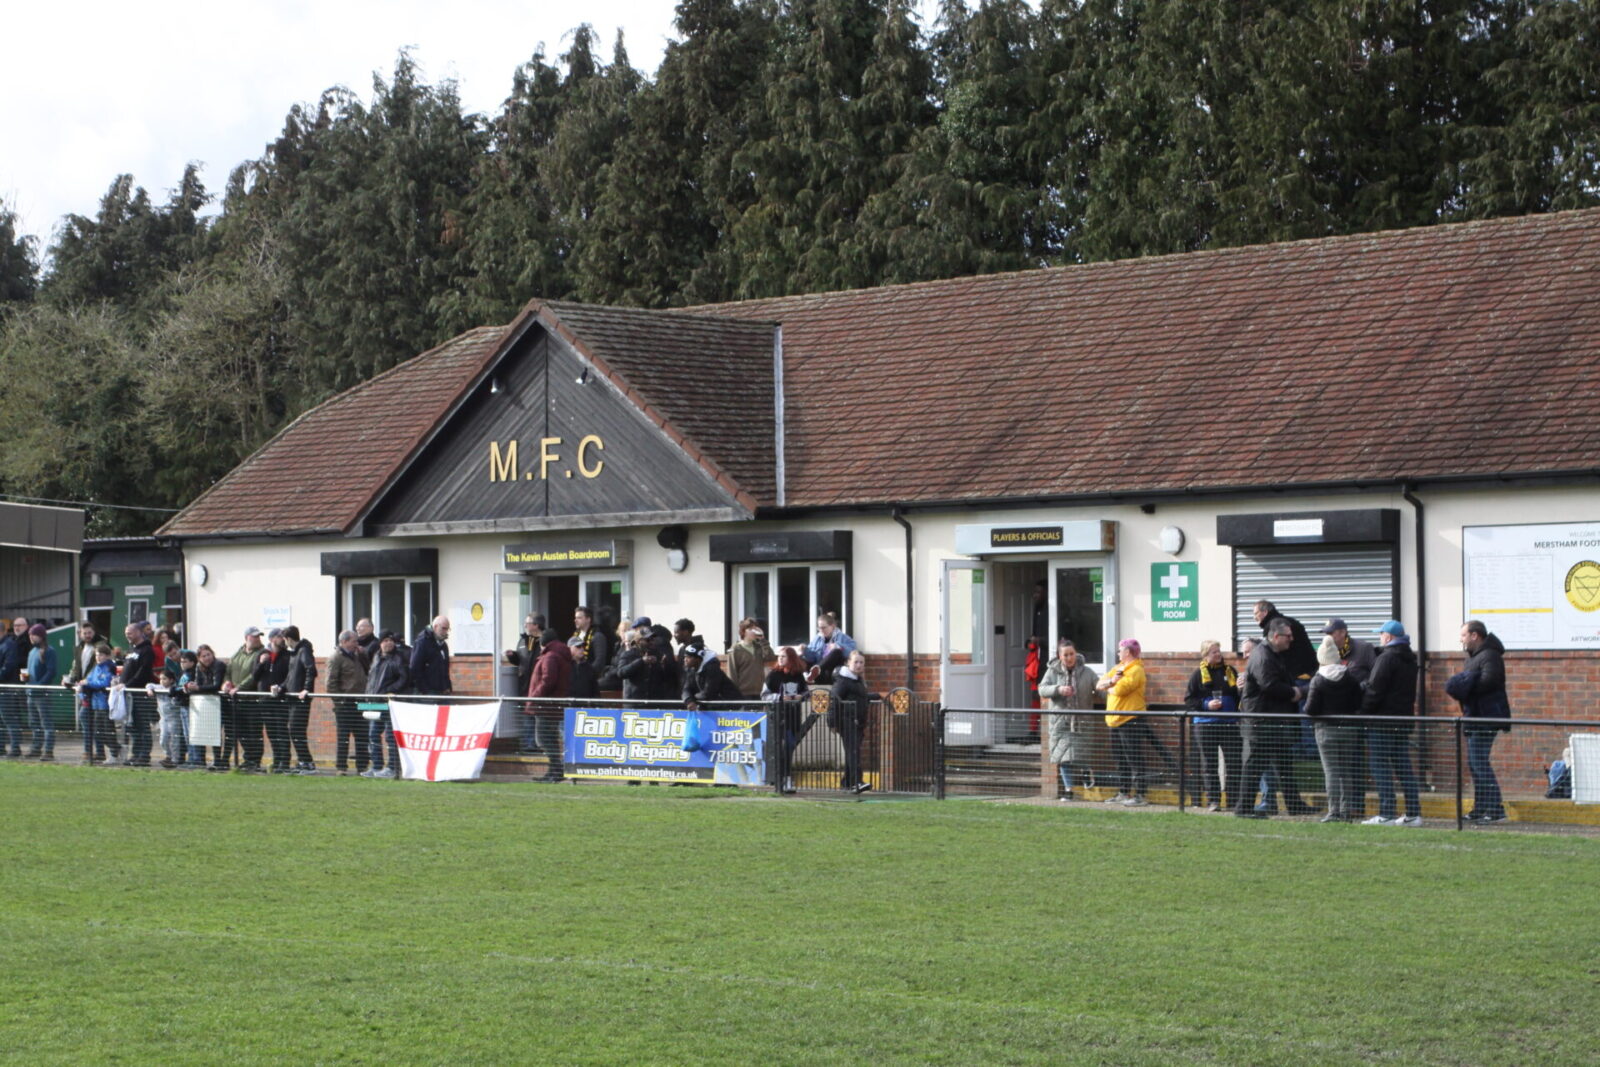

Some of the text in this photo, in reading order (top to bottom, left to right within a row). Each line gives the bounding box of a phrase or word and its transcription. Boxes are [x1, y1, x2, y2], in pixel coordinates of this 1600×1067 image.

[993, 533, 1020, 541] PLAYERS
[1027, 531, 1060, 540] OFFICIALS
[1534, 540, 1578, 549] MERSTHAM
[506, 549, 610, 562] The Kevin Austen Boardroom
[1157, 600, 1192, 609] FIRST AID
[1163, 610, 1186, 619] ROOM
[574, 711, 701, 743] Ian Taylo
[717, 716, 750, 728] Horley
[712, 731, 753, 745] 01293
[584, 740, 690, 763] Body Repairs
[709, 749, 757, 764] 781035
[576, 767, 698, 781] www.paintshophorley.co.uk
